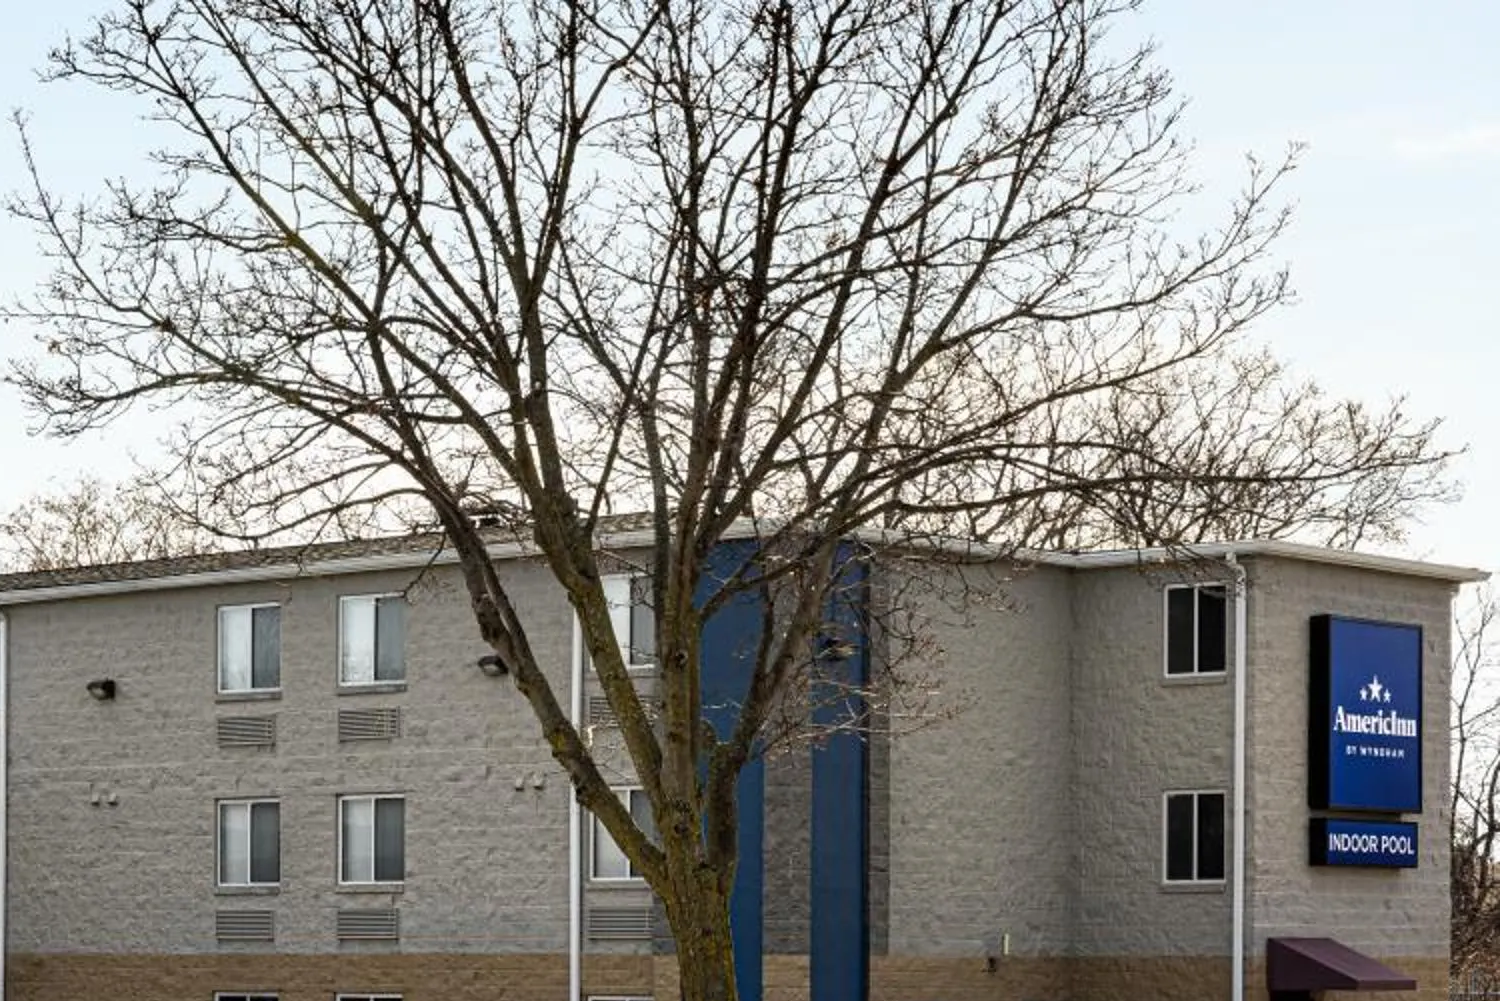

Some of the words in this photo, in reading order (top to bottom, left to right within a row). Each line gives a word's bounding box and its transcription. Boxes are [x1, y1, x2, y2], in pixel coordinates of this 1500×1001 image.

[1333, 705, 1417, 737] AmericInn
[1329, 832, 1378, 853] INDOOR
[1381, 835, 1415, 855] POOL
